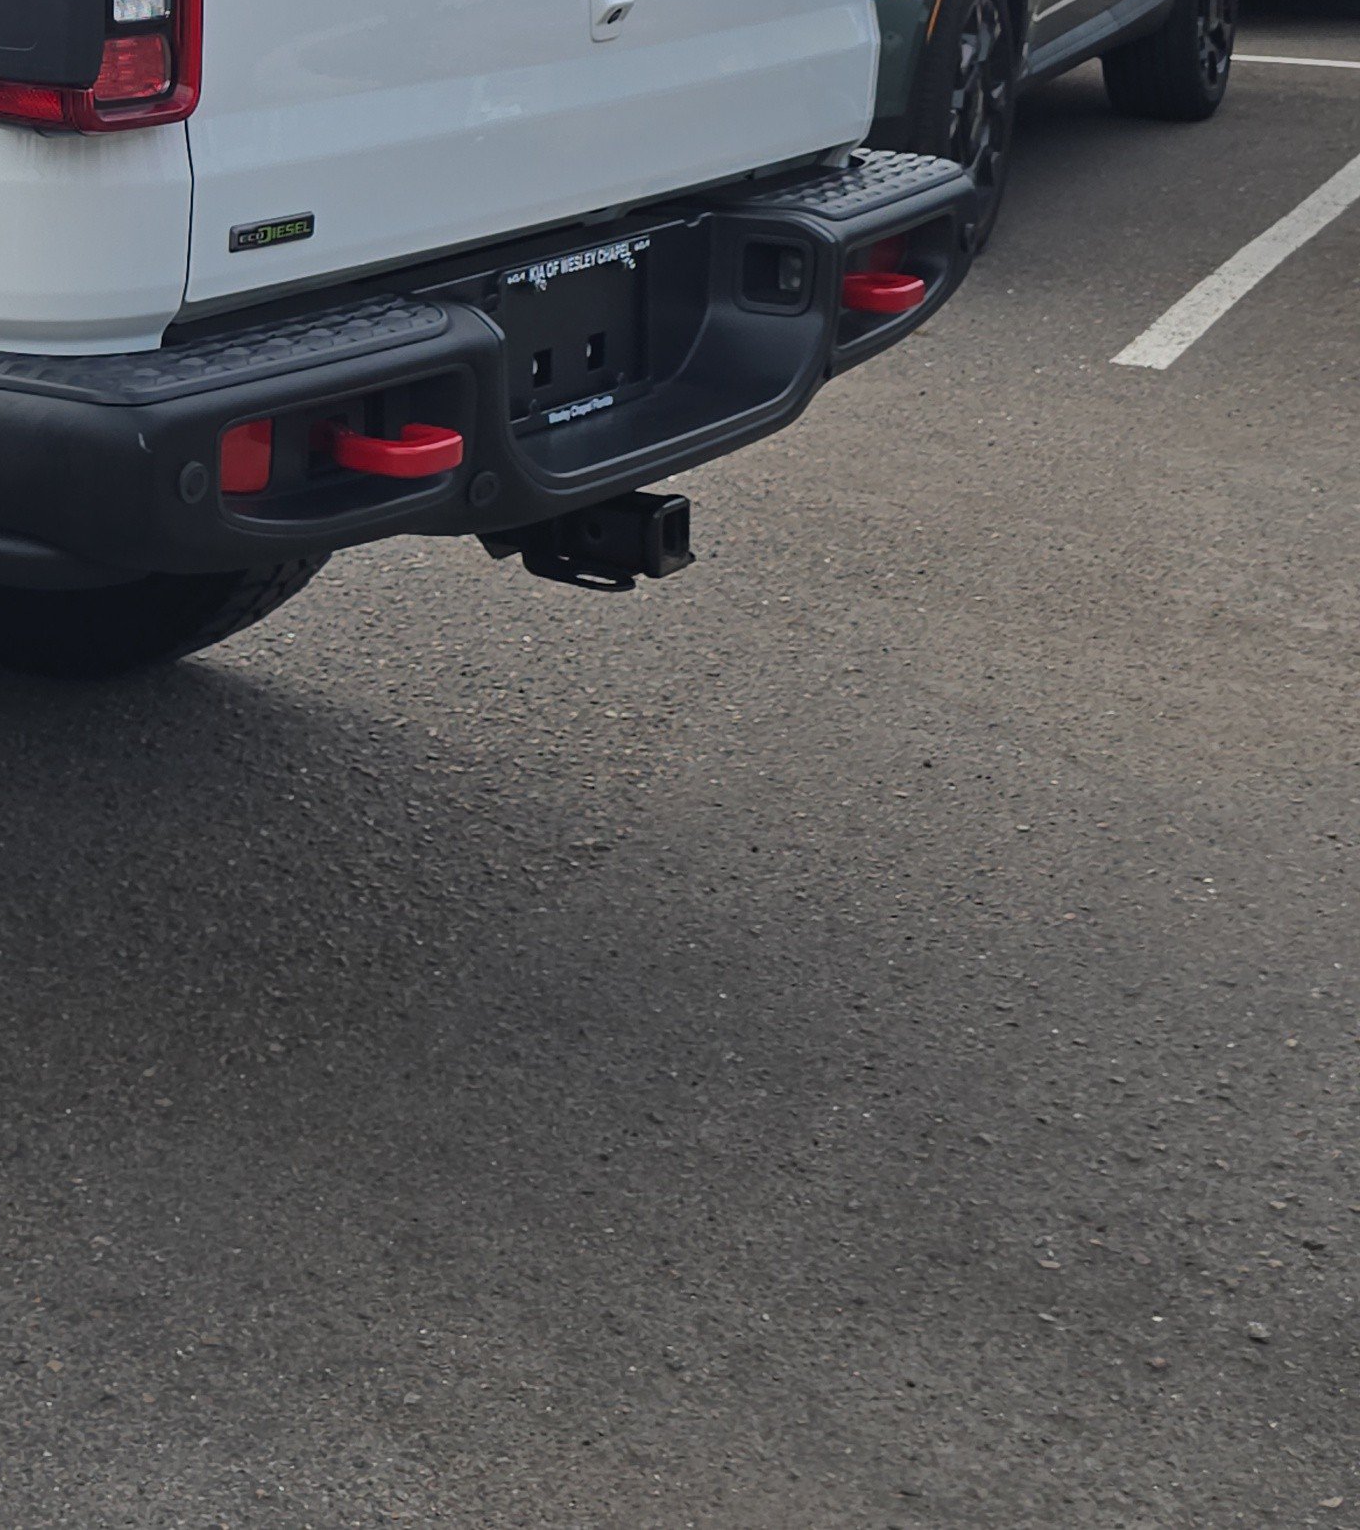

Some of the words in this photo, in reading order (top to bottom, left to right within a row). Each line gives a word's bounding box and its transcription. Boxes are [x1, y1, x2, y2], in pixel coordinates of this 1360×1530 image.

[546, 261, 560, 278] OF
[561, 252, 595, 273] WESLEY
[597, 244, 630, 263] CHAPEL
